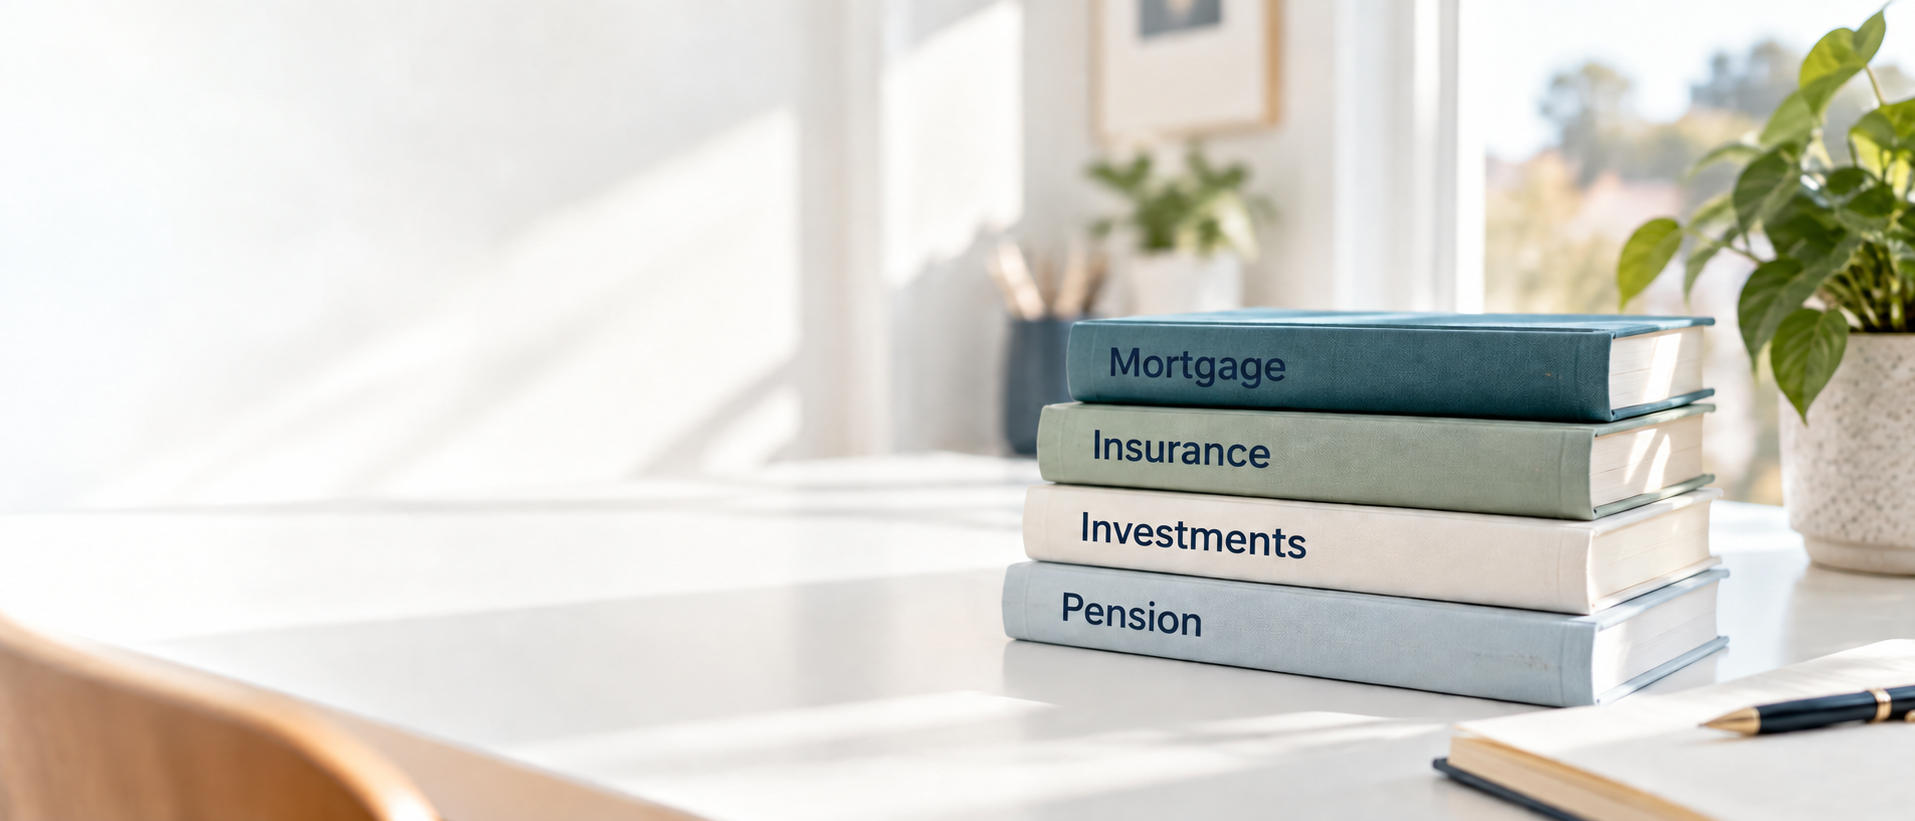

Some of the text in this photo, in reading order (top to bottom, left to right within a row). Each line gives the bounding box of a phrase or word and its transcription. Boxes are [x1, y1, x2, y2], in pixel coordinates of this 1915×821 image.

[1109, 347, 1287, 390] Mortgage
[1093, 429, 1271, 469] Insurance
[1081, 511, 1307, 560] Investments
[1062, 592, 1202, 637] Pension
